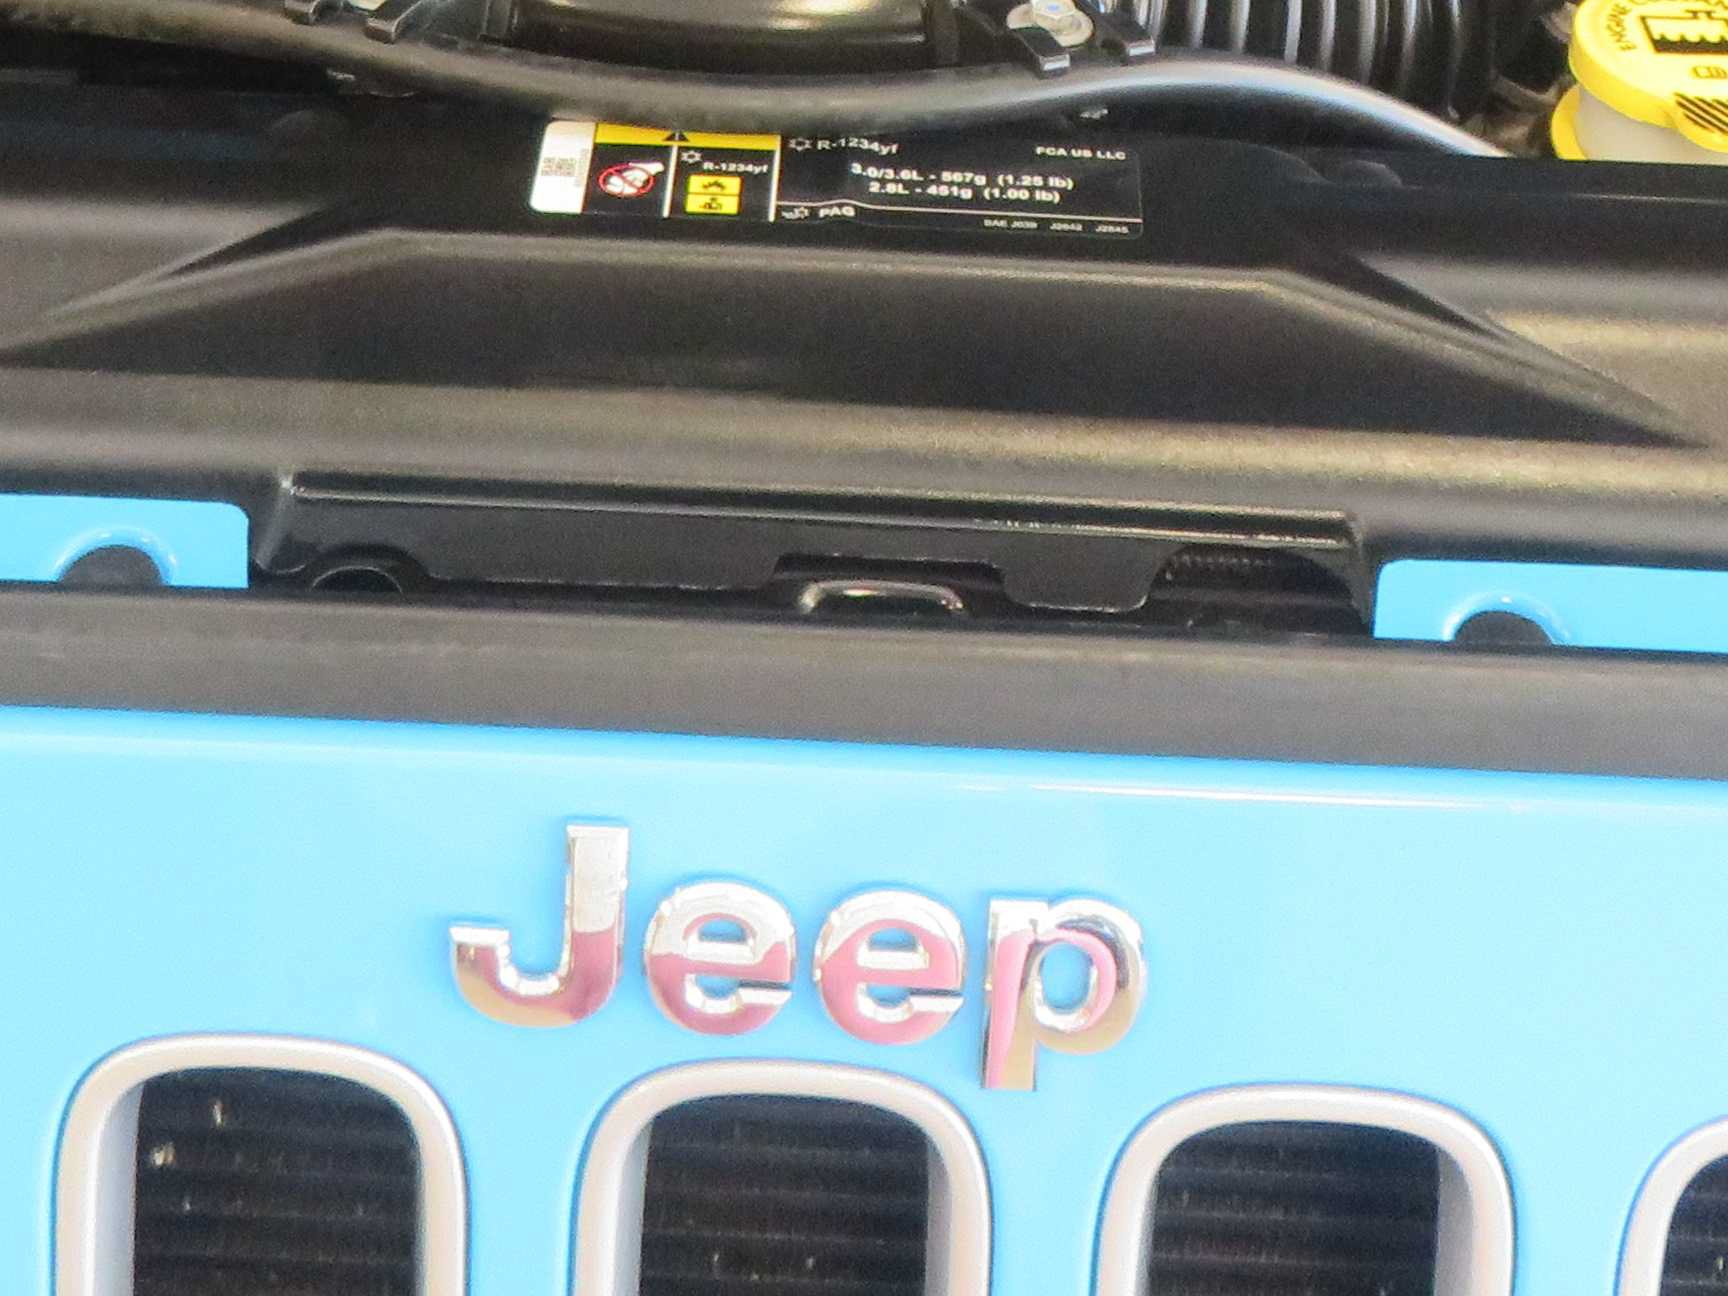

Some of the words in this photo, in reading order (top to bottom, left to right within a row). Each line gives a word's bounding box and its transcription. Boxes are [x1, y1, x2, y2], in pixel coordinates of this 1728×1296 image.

[817, 137, 899, 155] R-1234yf
[1035, 145, 1068, 157] FCA
[1070, 148, 1093, 158] US
[1096, 149, 1127, 161] LLC
[702, 161, 769, 175] R-1234yf
[997, 173, 1044, 187] (1.25
[1048, 176, 1075, 190] lb)
[983, 186, 1030, 200] (1.00
[1035, 190, 1061, 204] lb)
[818, 205, 856, 218] PAG
[447, 821, 1147, 1092] Jeep
